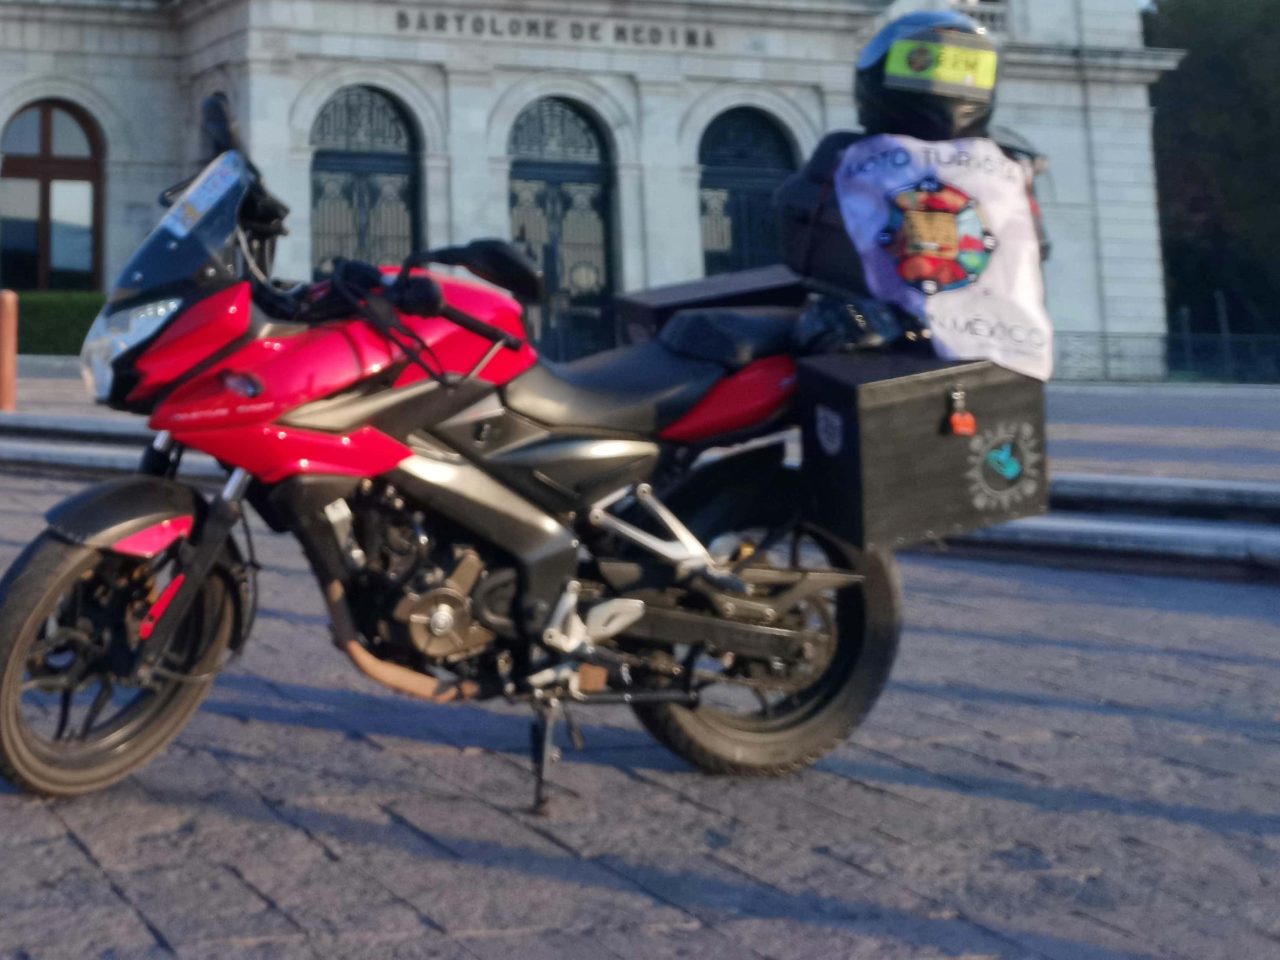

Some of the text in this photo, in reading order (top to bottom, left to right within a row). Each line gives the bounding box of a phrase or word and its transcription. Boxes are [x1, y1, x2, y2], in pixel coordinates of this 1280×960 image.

[396, 10, 716, 48] BARTOLOME DE MEDINA
